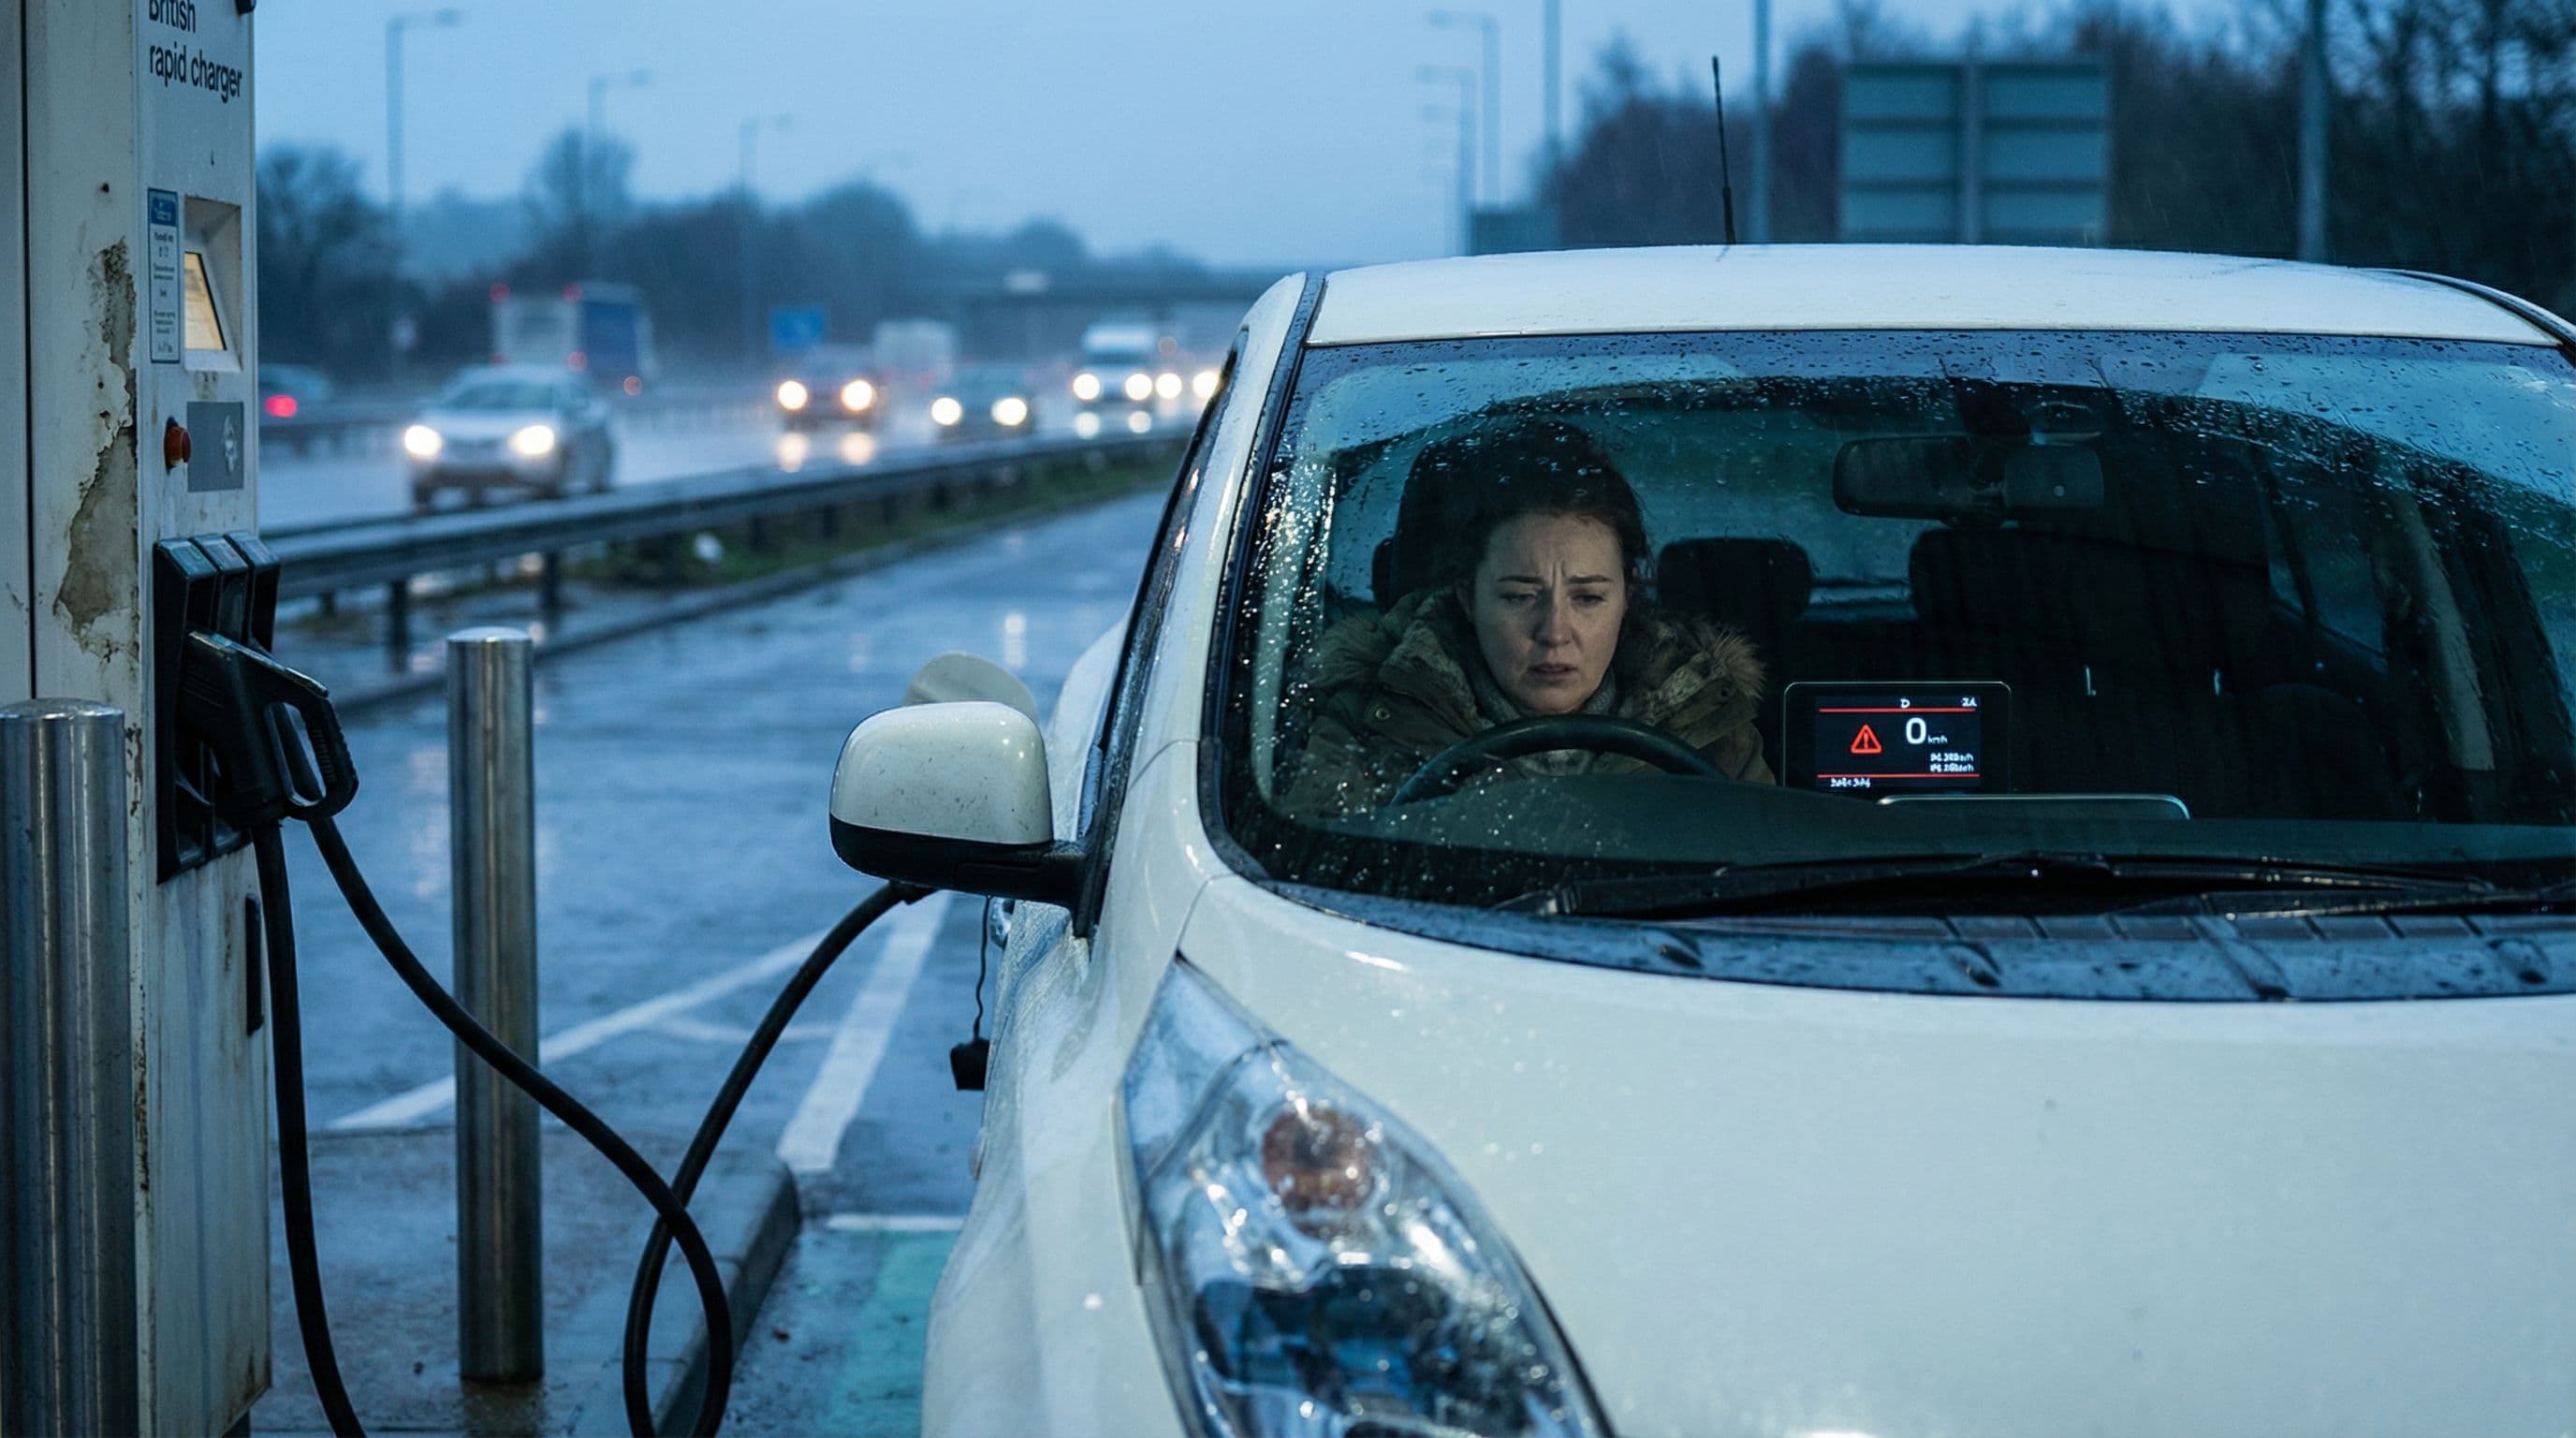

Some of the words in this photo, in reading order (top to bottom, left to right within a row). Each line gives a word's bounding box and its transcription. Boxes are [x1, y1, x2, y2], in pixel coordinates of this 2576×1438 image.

[149, 0, 196, 34] British
[150, 41, 186, 87] rapid
[191, 50, 242, 103] charger
[1906, 717, 1926, 744] 0
